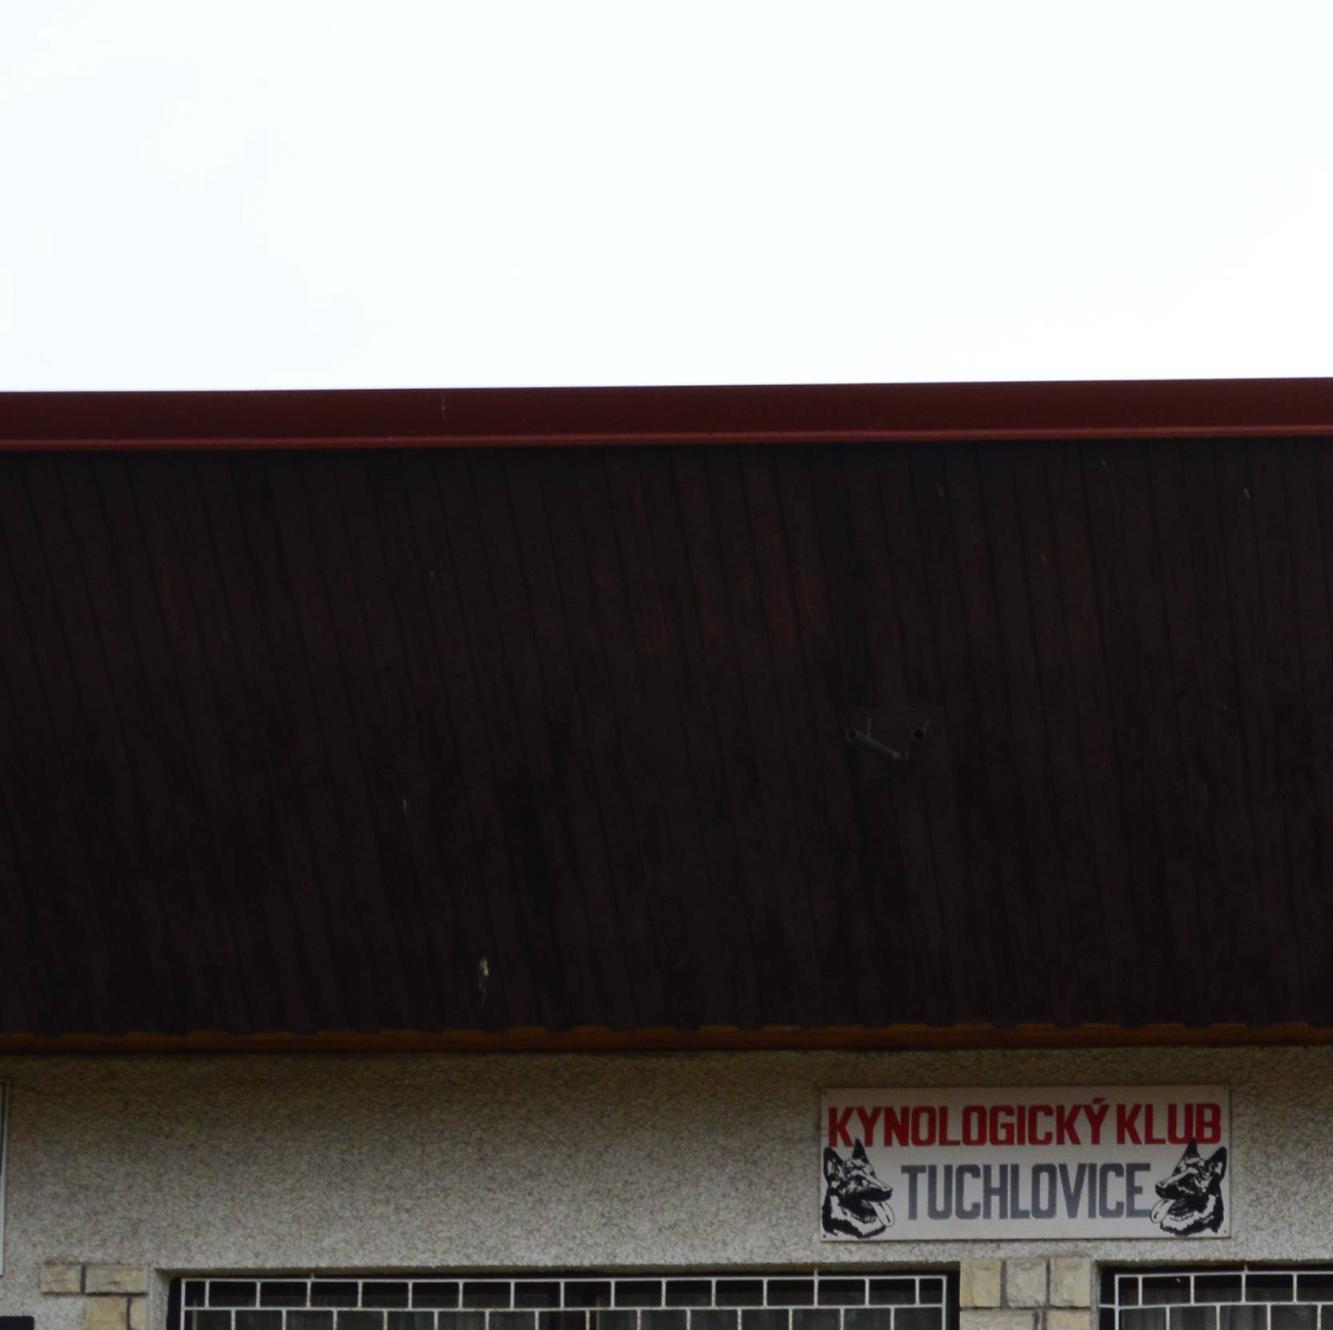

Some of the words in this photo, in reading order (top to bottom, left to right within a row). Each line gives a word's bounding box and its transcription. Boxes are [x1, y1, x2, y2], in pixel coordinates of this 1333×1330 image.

[829, 1098, 1109, 1148] KYNOLOGICKÝ
[1116, 1103, 1222, 1145] KLUB
[901, 1162, 1151, 1221] TUCHLOVICE
